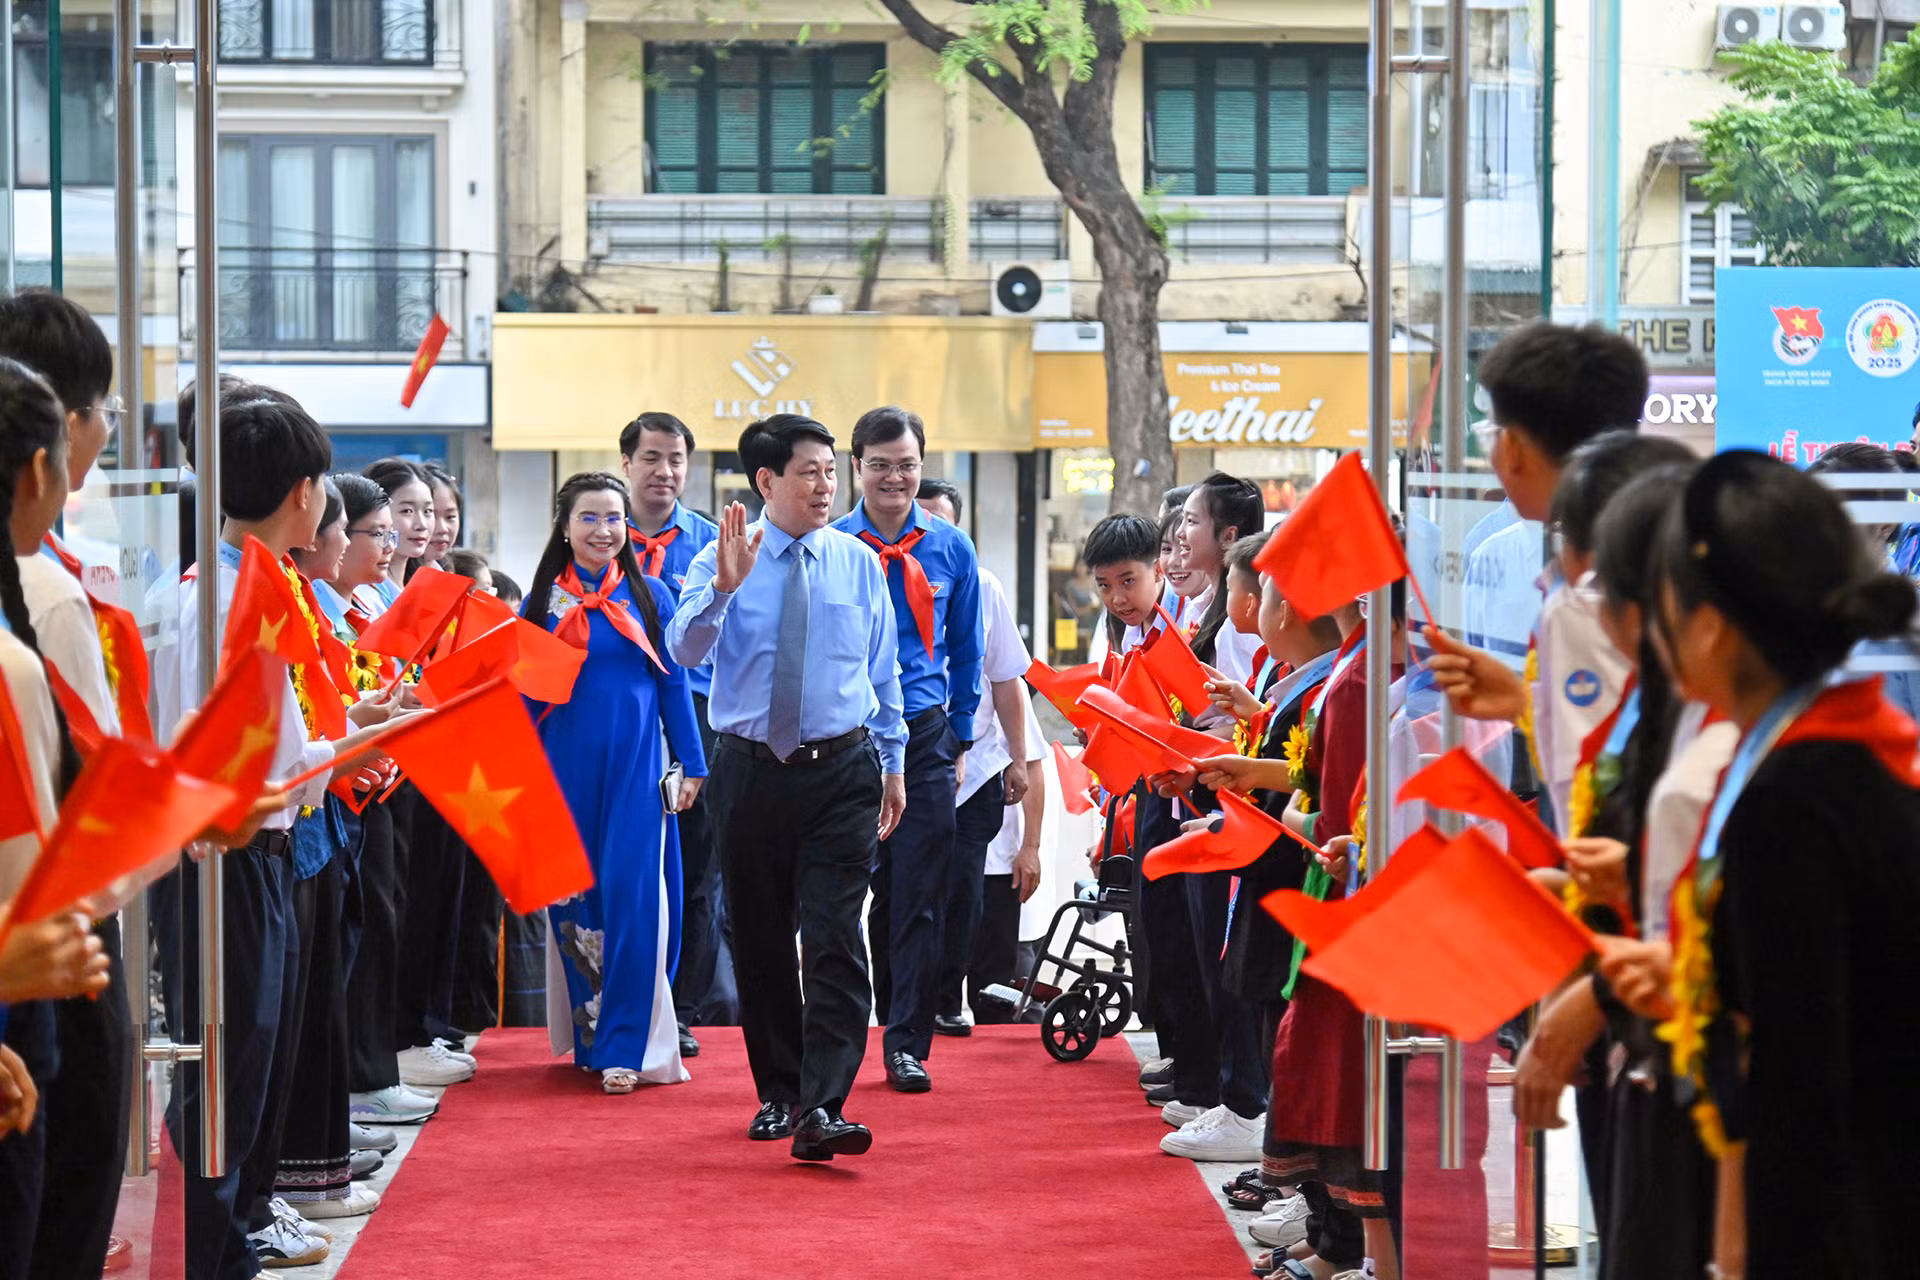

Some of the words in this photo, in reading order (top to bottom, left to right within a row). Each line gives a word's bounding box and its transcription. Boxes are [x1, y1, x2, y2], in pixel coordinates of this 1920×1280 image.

[1177, 362, 1230, 375] Premium
[1232, 362, 1258, 375] Thai
[1259, 362, 1281, 375] Tea
[1867, 357, 1902, 369] 2025
[1241, 380, 1281, 393] Cream
[1638, 393, 1719, 424] ORY
[1168, 396, 1323, 443] eethai
